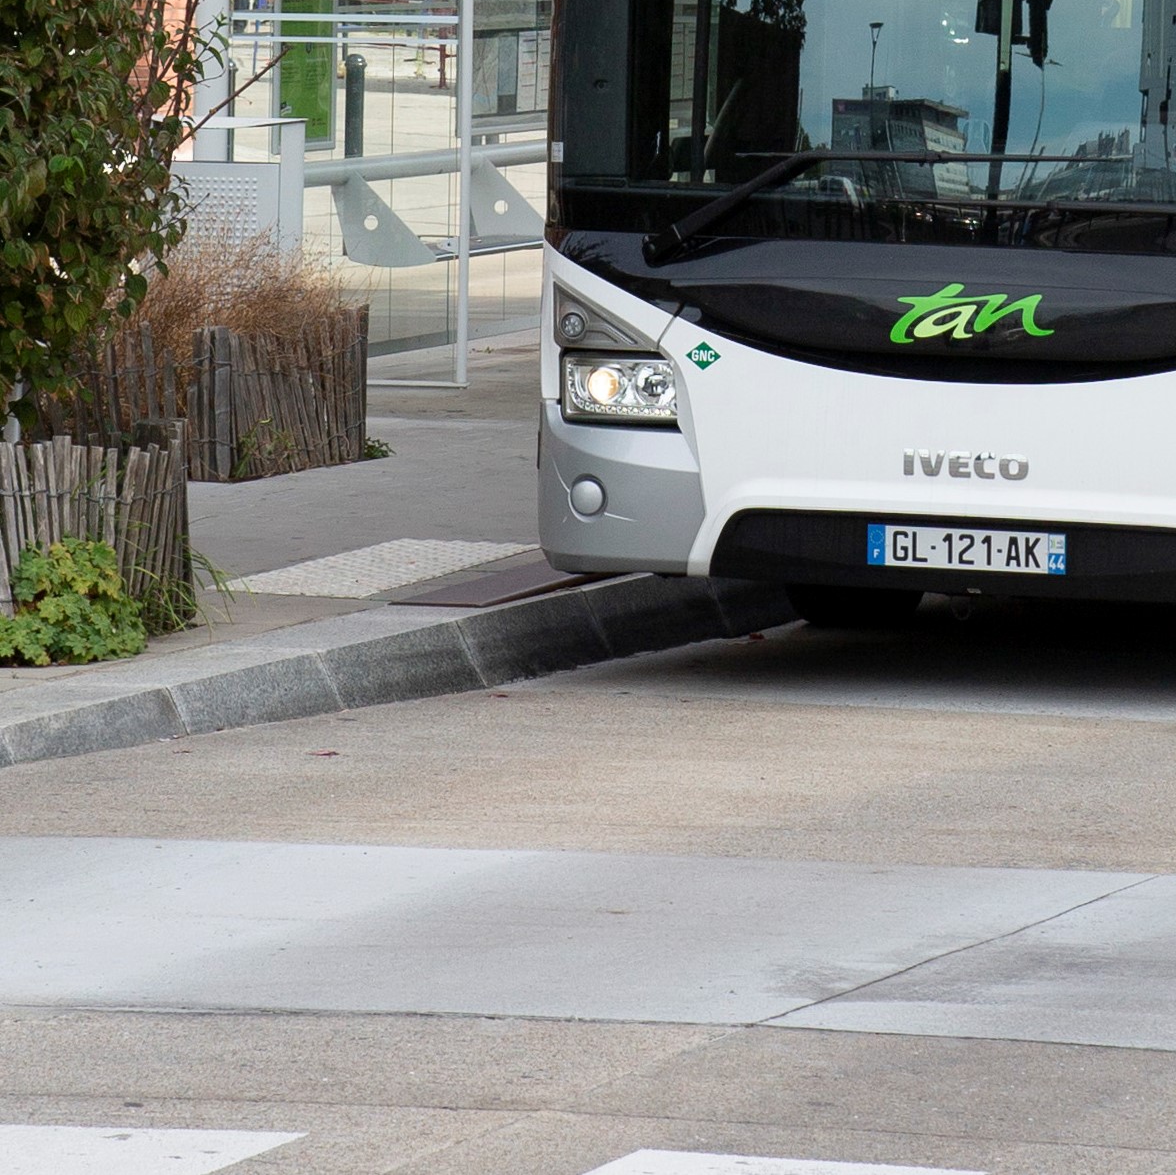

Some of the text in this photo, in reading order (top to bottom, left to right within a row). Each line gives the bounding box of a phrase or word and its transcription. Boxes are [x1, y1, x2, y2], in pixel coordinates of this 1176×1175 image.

[889, 283, 1055, 344] tan
[691, 349, 715, 362] GNC
[903, 448, 1030, 481] IVECO
[873, 549, 880, 559] F
[892, 530, 1042, 569] GL-121-AK
[1049, 555, 1065, 570] 44
